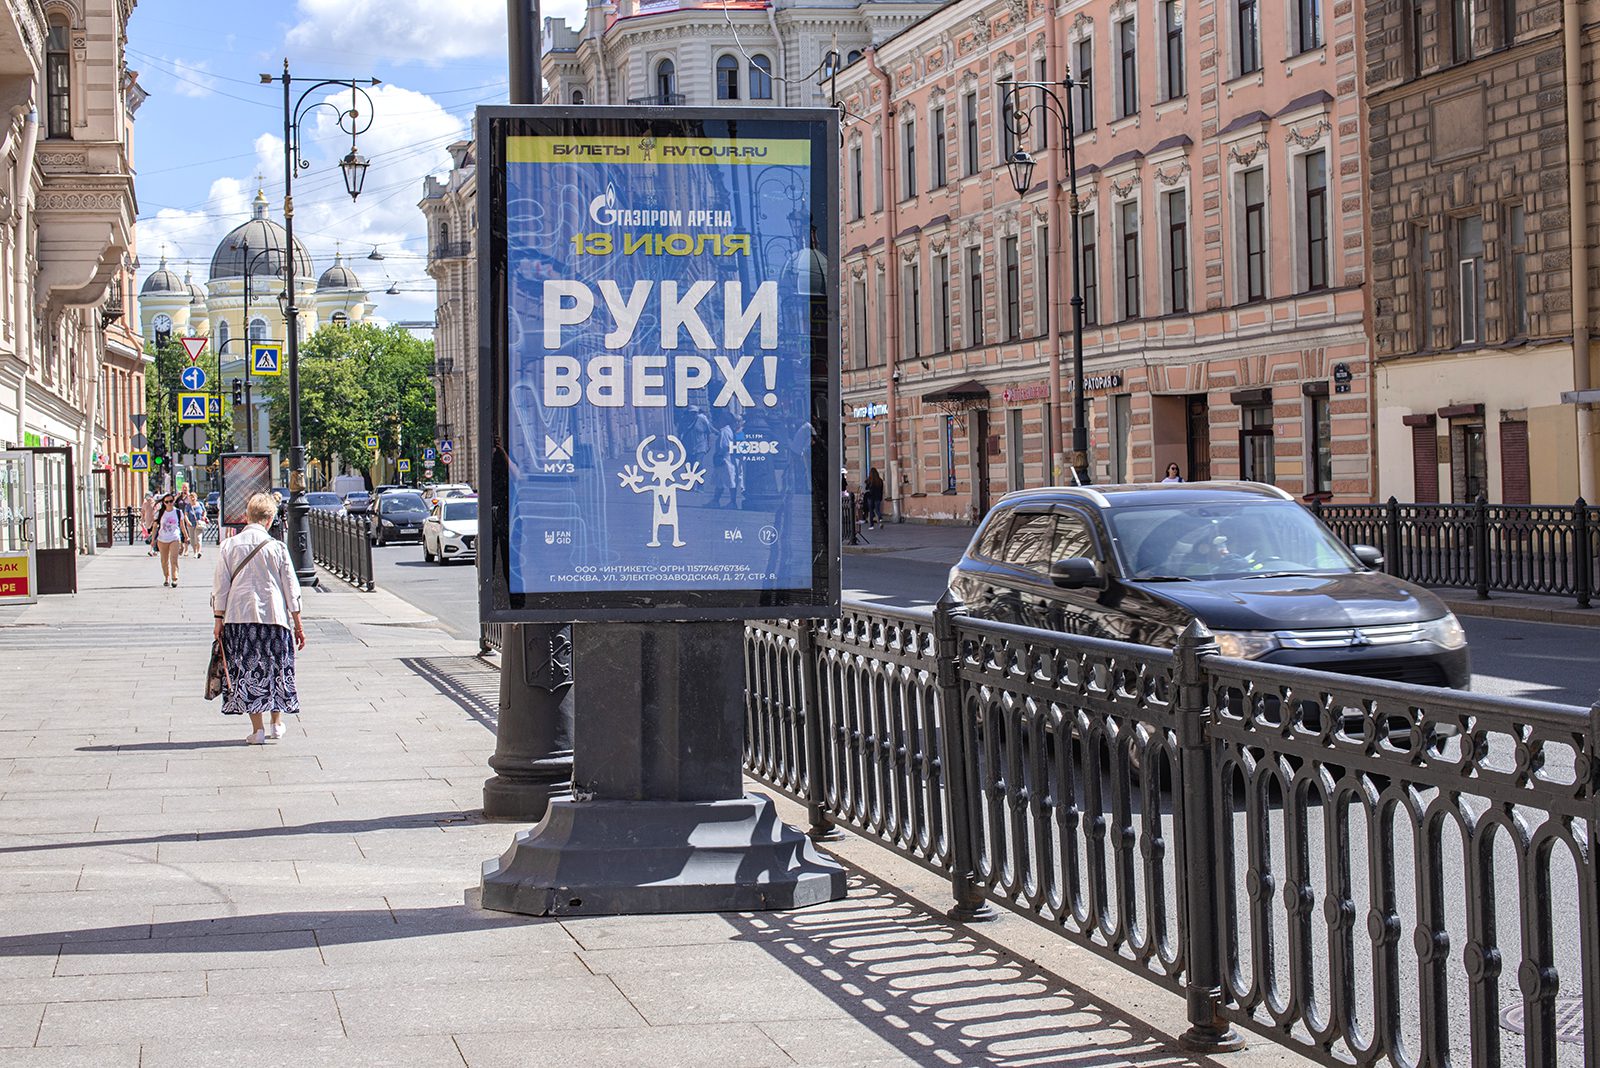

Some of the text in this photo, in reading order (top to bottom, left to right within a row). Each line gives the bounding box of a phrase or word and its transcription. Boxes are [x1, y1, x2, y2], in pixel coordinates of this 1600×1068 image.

[553, 144, 630, 156] БИЛЕТЫ
[663, 145, 768, 157] RVTOUR.RU
[617, 209, 732, 227] ГАЗПРОМ АРЕНА
[570, 233, 751, 256] 13 ИЮЛЯ
[543, 279, 778, 349] РУКИ
[543, 355, 778, 407] ВВЕРХ!
[544, 463, 575, 473] МУЗ
[762, 530, 776, 540] 12+
[659, 564, 685, 572] ОГРН
[687, 564, 750, 572] 1157746767364
[558, 574, 601, 582] МОСКВА,
[620, 573, 721, 582] ЭЛЕКТРОЗАВОДСКАЯ,
[723, 573, 733, 581] Д.
[734, 573, 747, 581] 27,
